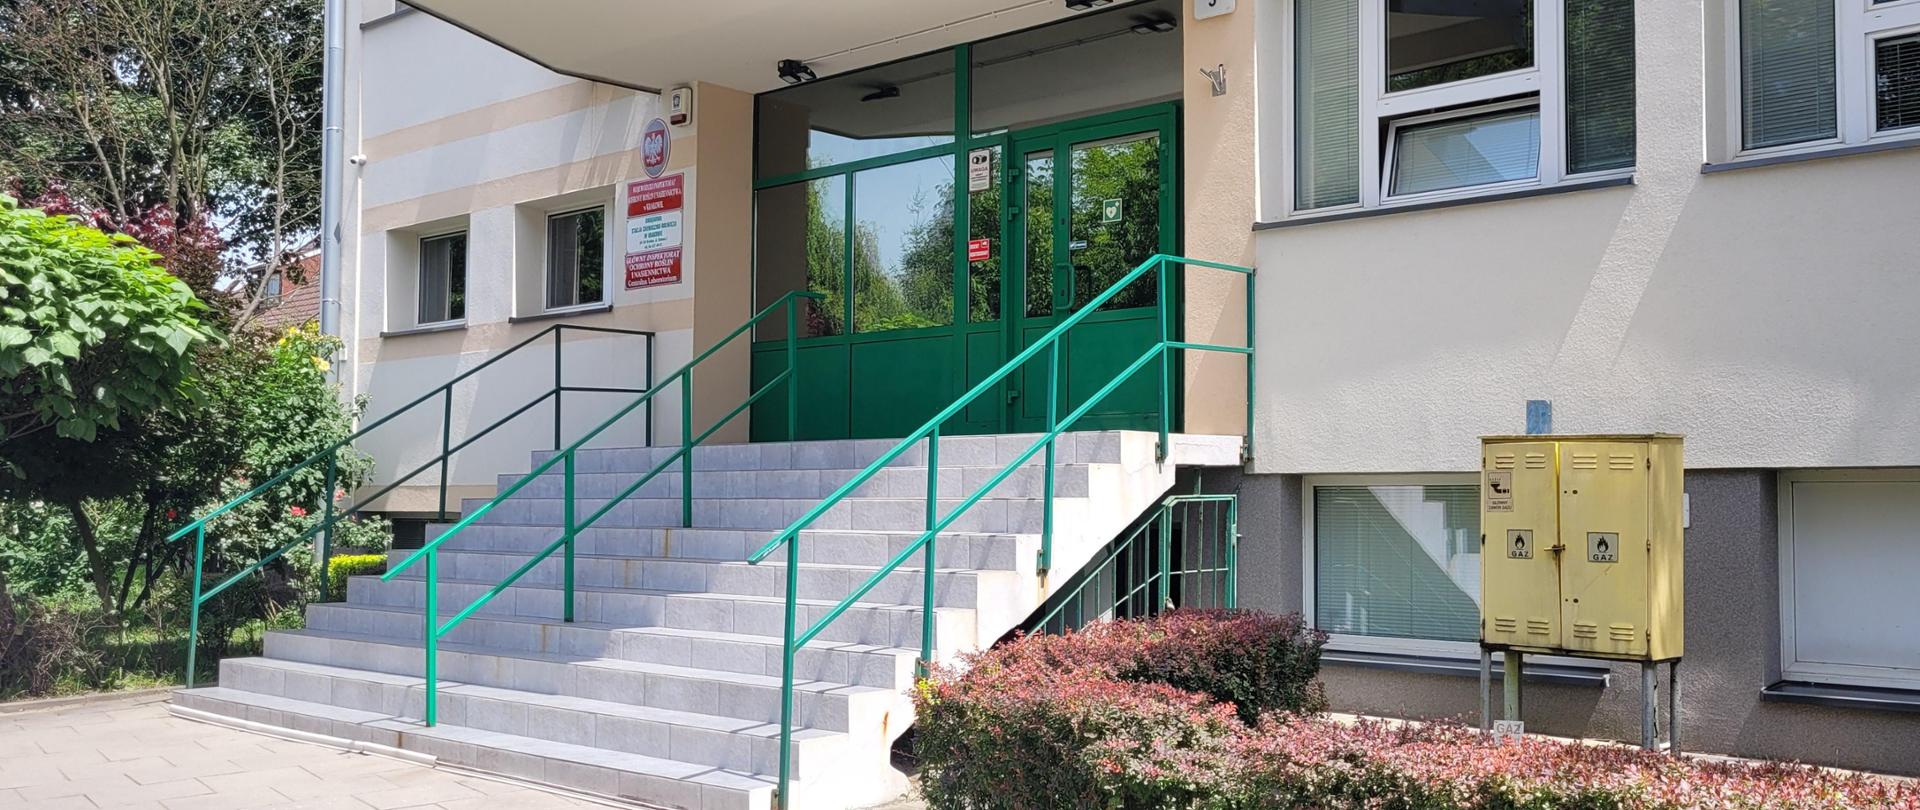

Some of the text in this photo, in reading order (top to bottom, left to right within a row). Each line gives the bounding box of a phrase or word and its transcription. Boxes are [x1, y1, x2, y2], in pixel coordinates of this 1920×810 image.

[646, 250, 680, 262] INSPEKTORAT
[629, 257, 674, 271] OCHRONY ROŚLIN
[634, 267, 672, 278] NASIENNICTWA
[1496, 723, 1522, 735] GAZ
